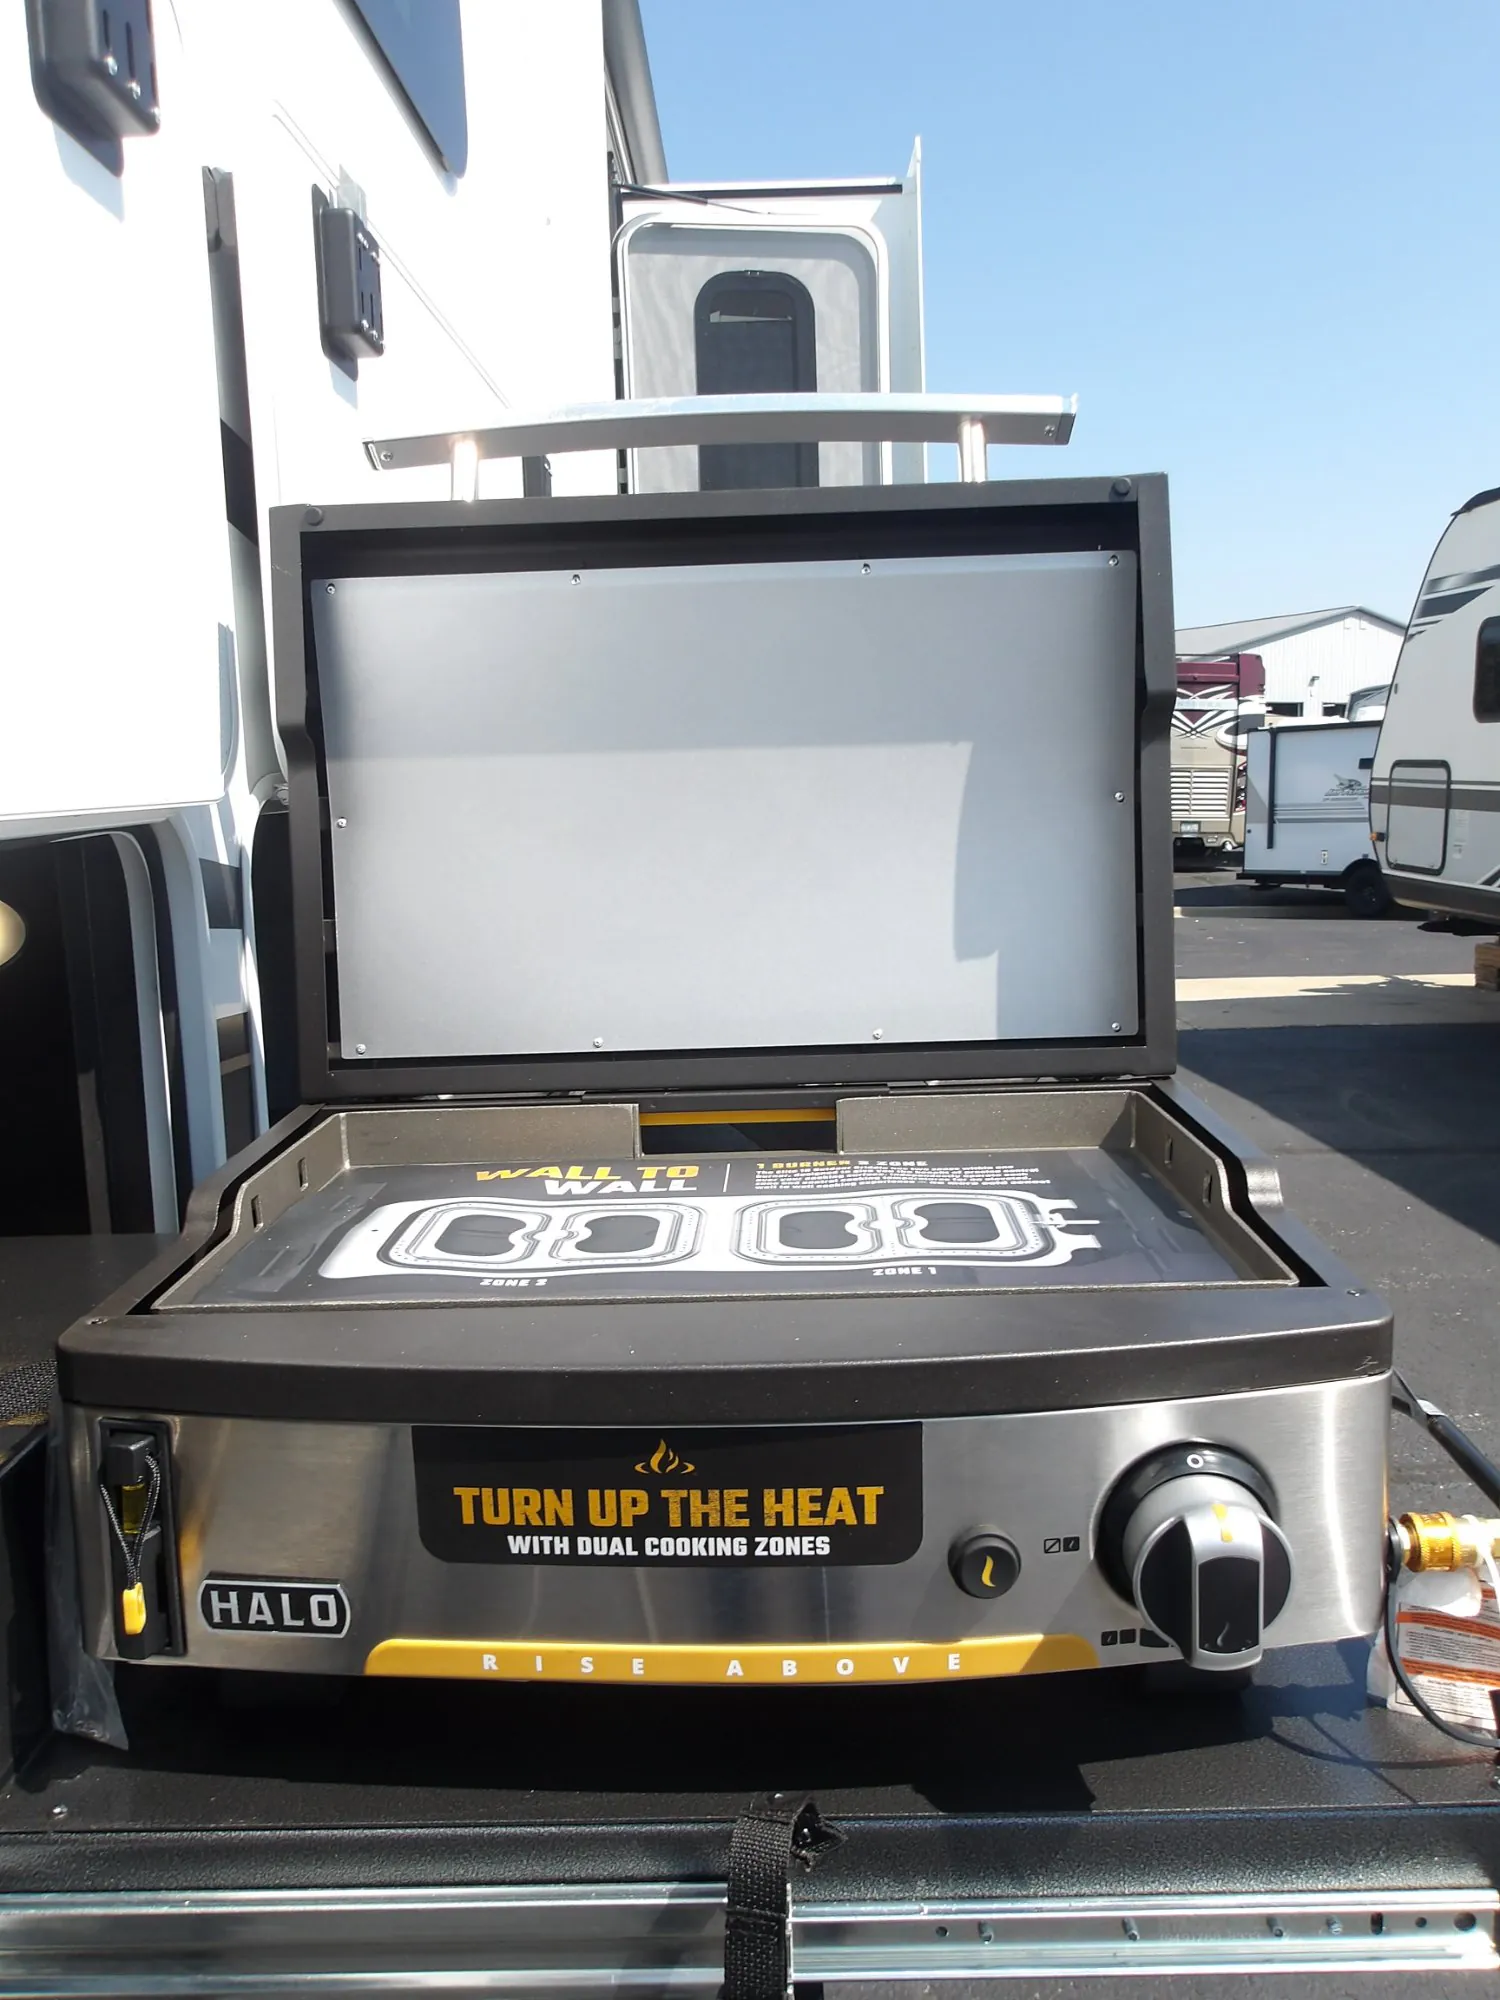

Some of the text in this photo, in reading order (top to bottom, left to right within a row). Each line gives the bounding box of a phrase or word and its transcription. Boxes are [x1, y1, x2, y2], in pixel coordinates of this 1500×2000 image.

[476, 1165, 700, 1181] WALL TO
[544, 1179, 698, 1195] WALL
[872, 1268, 923, 1276] ZONE
[480, 1279, 531, 1288] ZONE
[453, 1485, 884, 1528] TURN UP THE HEAT
[507, 1534, 831, 1557] WITH DUAL COOKING ZONES
[209, 1590, 338, 1628] HALO
[482, 1653, 961, 1677] RISE ABOVE
